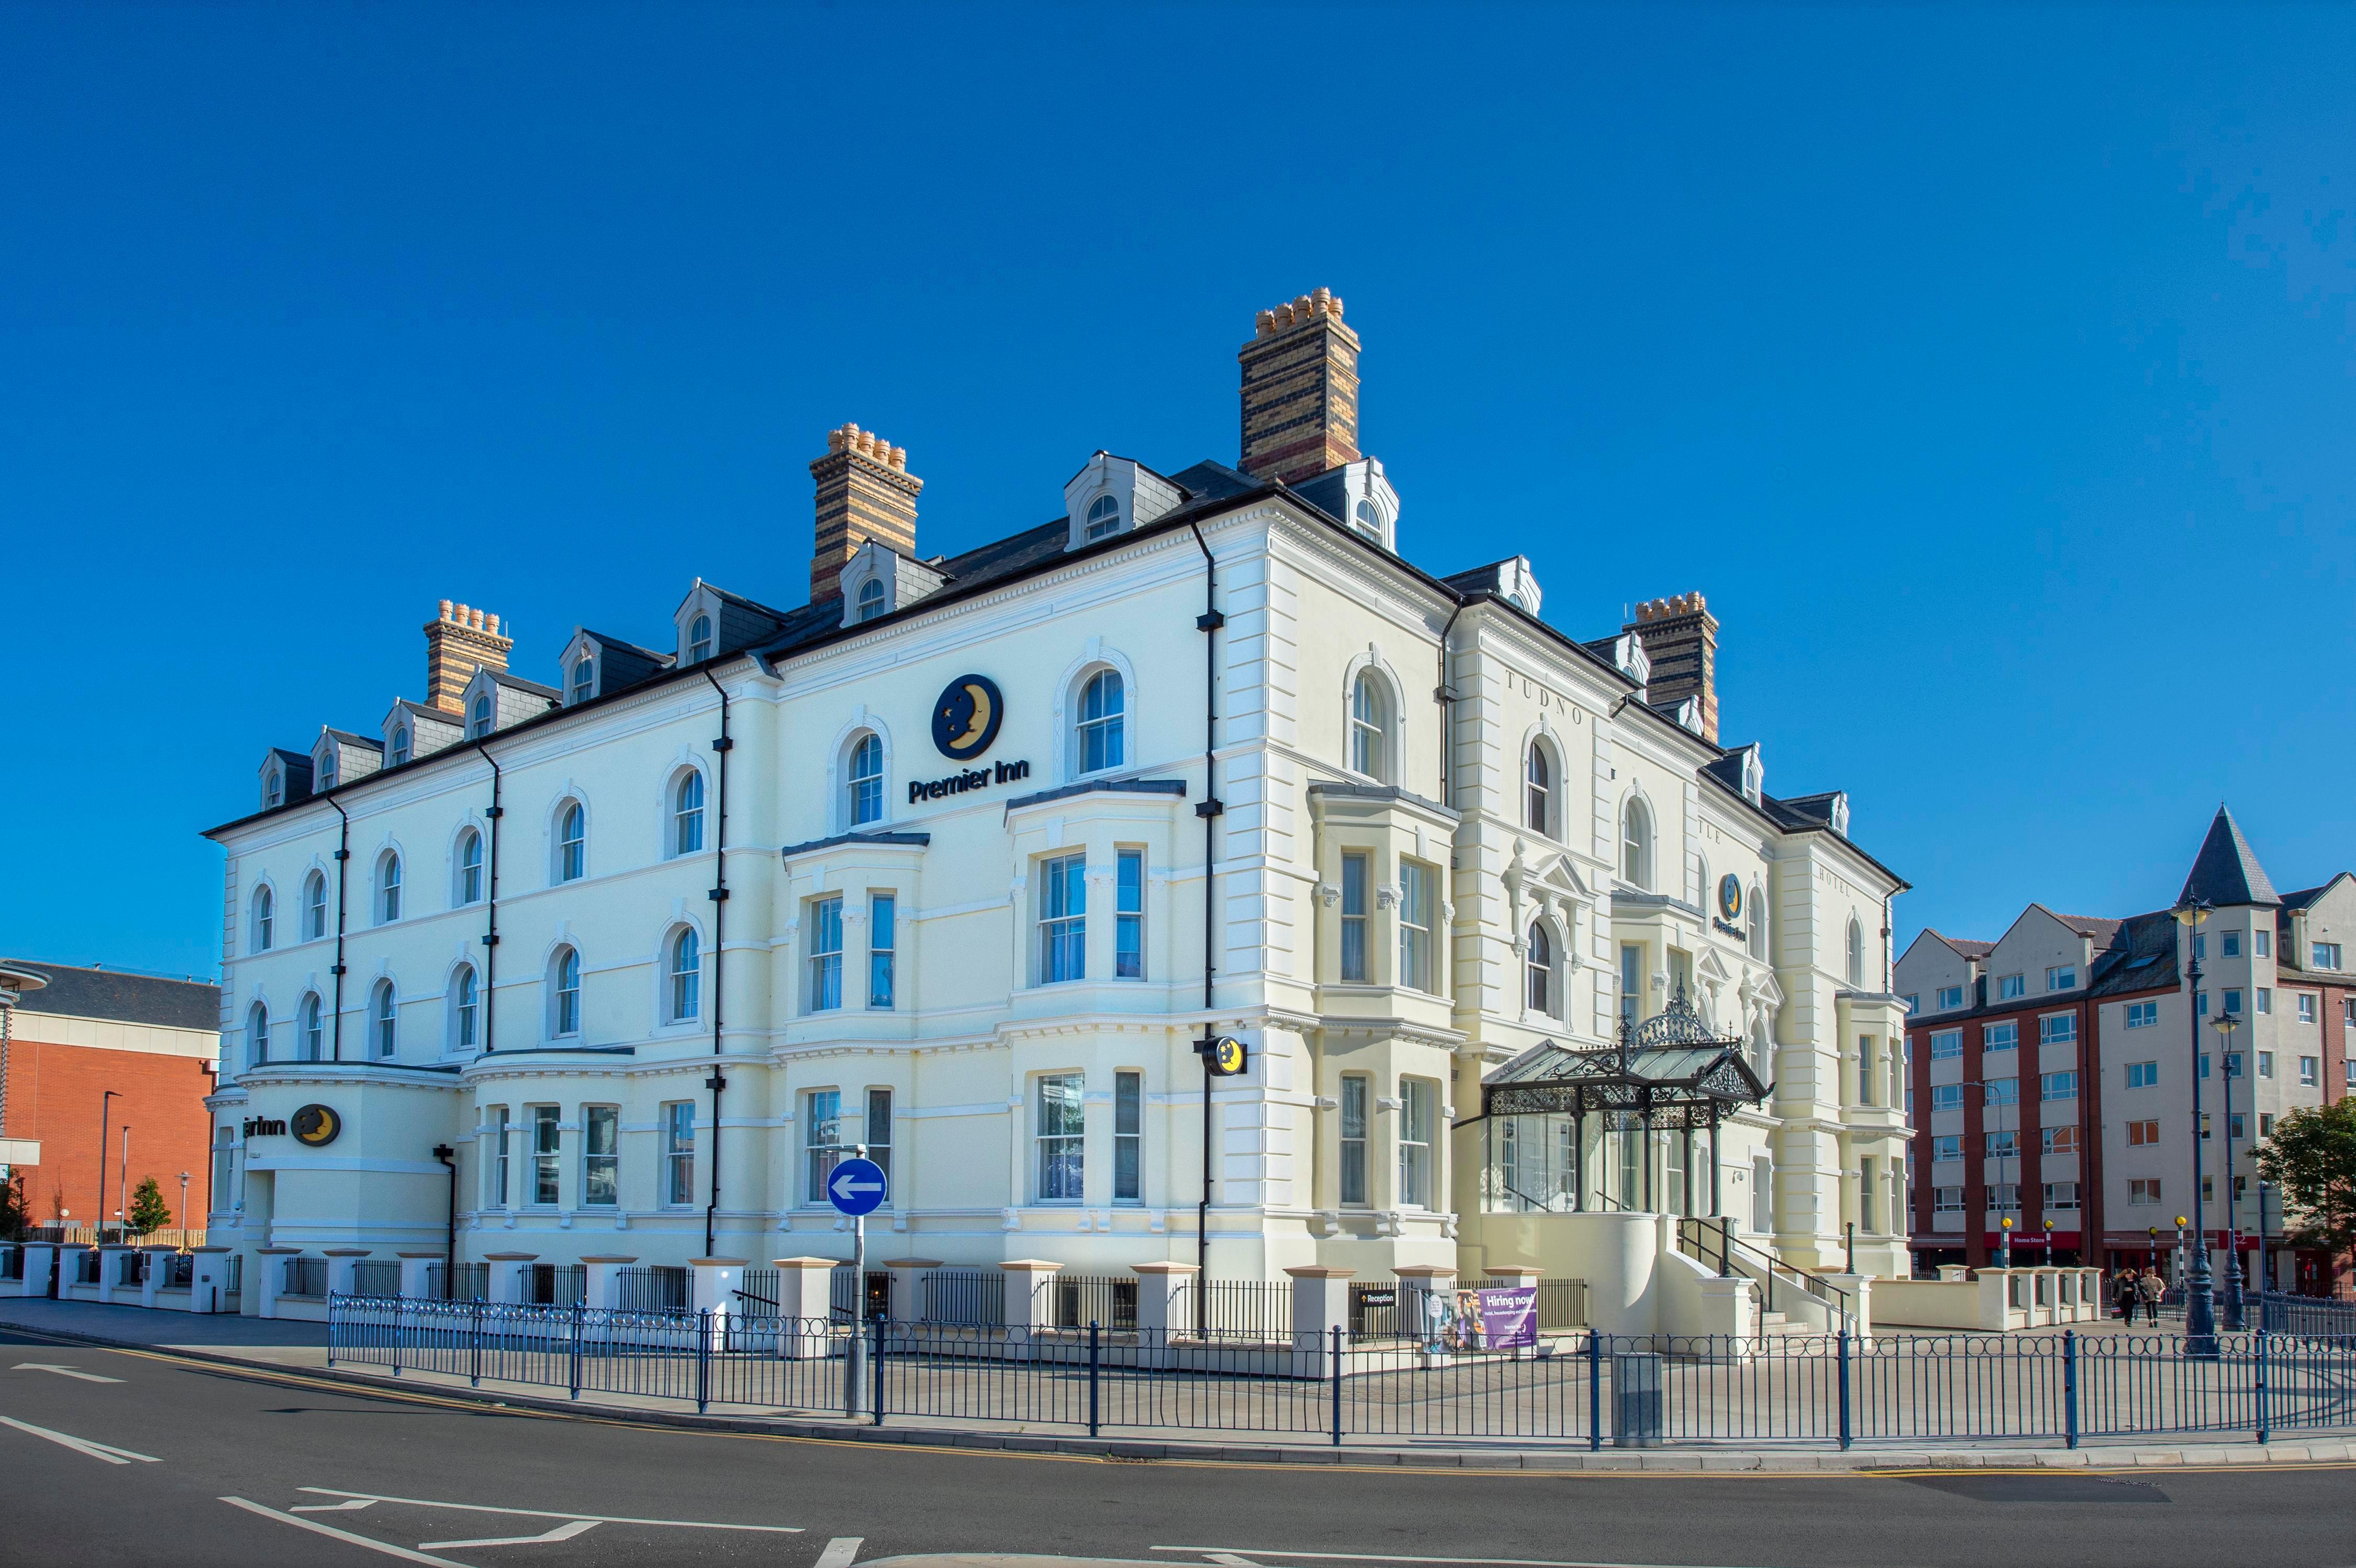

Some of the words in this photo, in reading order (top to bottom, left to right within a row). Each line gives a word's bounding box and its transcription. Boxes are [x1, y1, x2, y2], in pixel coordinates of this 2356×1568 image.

[1505, 670, 1581, 725] TUDNO
[909, 768, 992, 804] Premier
[995, 760, 1029, 784] Inn
[1819, 868, 1850, 897] HOTEL
[1713, 916, 1736, 937] Premier
[257, 1116, 285, 1136] Inn
[1368, 1294, 1394, 1304] Reception
[1486, 1295, 1514, 1308] Hiring
